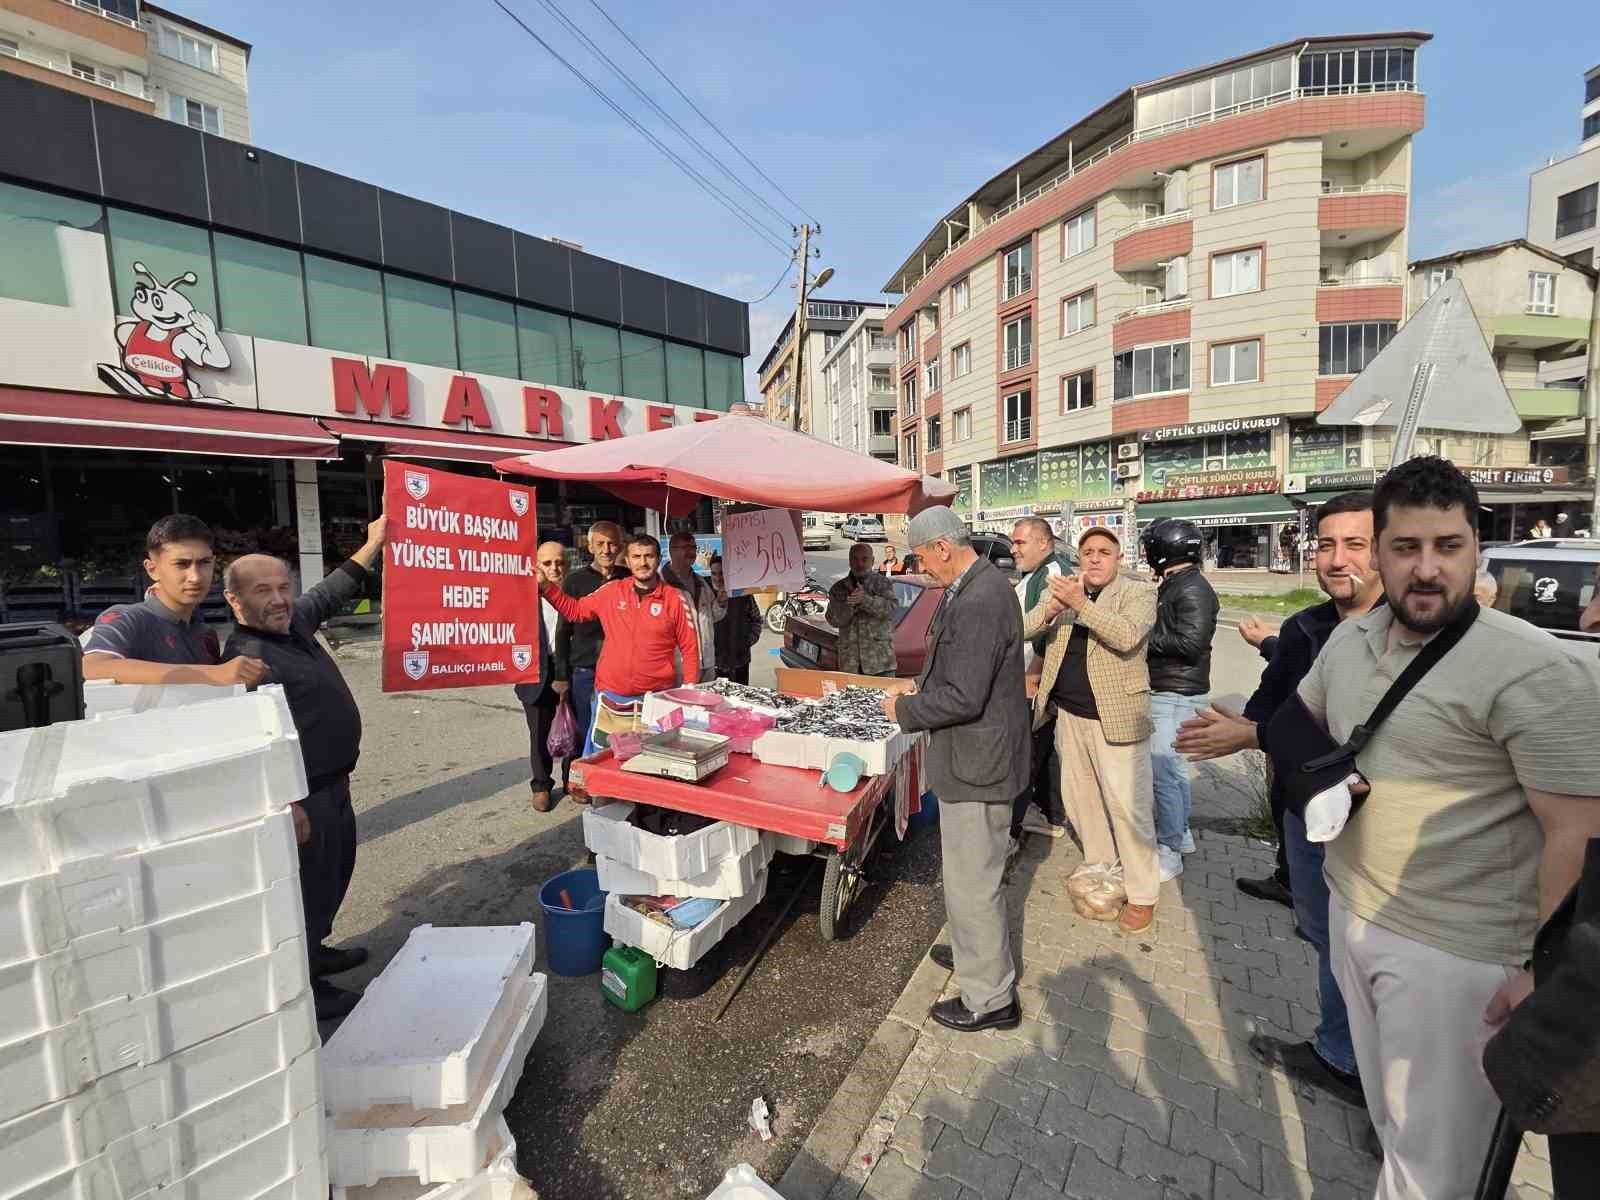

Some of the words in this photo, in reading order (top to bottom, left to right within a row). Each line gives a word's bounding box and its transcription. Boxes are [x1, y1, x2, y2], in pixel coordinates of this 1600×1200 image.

[131, 356, 177, 373] Çelikler
[1155, 424, 1195, 441] ÇİFTLİK
[1197, 419, 1240, 434] SÜRÜCÜ
[1242, 417, 1281, 430] KURSU
[1178, 475, 1208, 487] ÇİFTLİK
[1209, 471, 1244, 483] SÜRÜCÜ
[1245, 469, 1275, 480] KURSU
[406, 503, 461, 535] BÜYÜK
[464, 512, 519, 543] BAŞKAN
[391, 540, 454, 571] YÜKSEL
[458, 548, 534, 577] YILDIRIMLA
[442, 584, 490, 609] HEDEF
[411, 617, 516, 651] ŞAMPİYONLUK
[431, 661, 475, 676] BALIKÇI
[477, 658, 507, 673] HABİL
